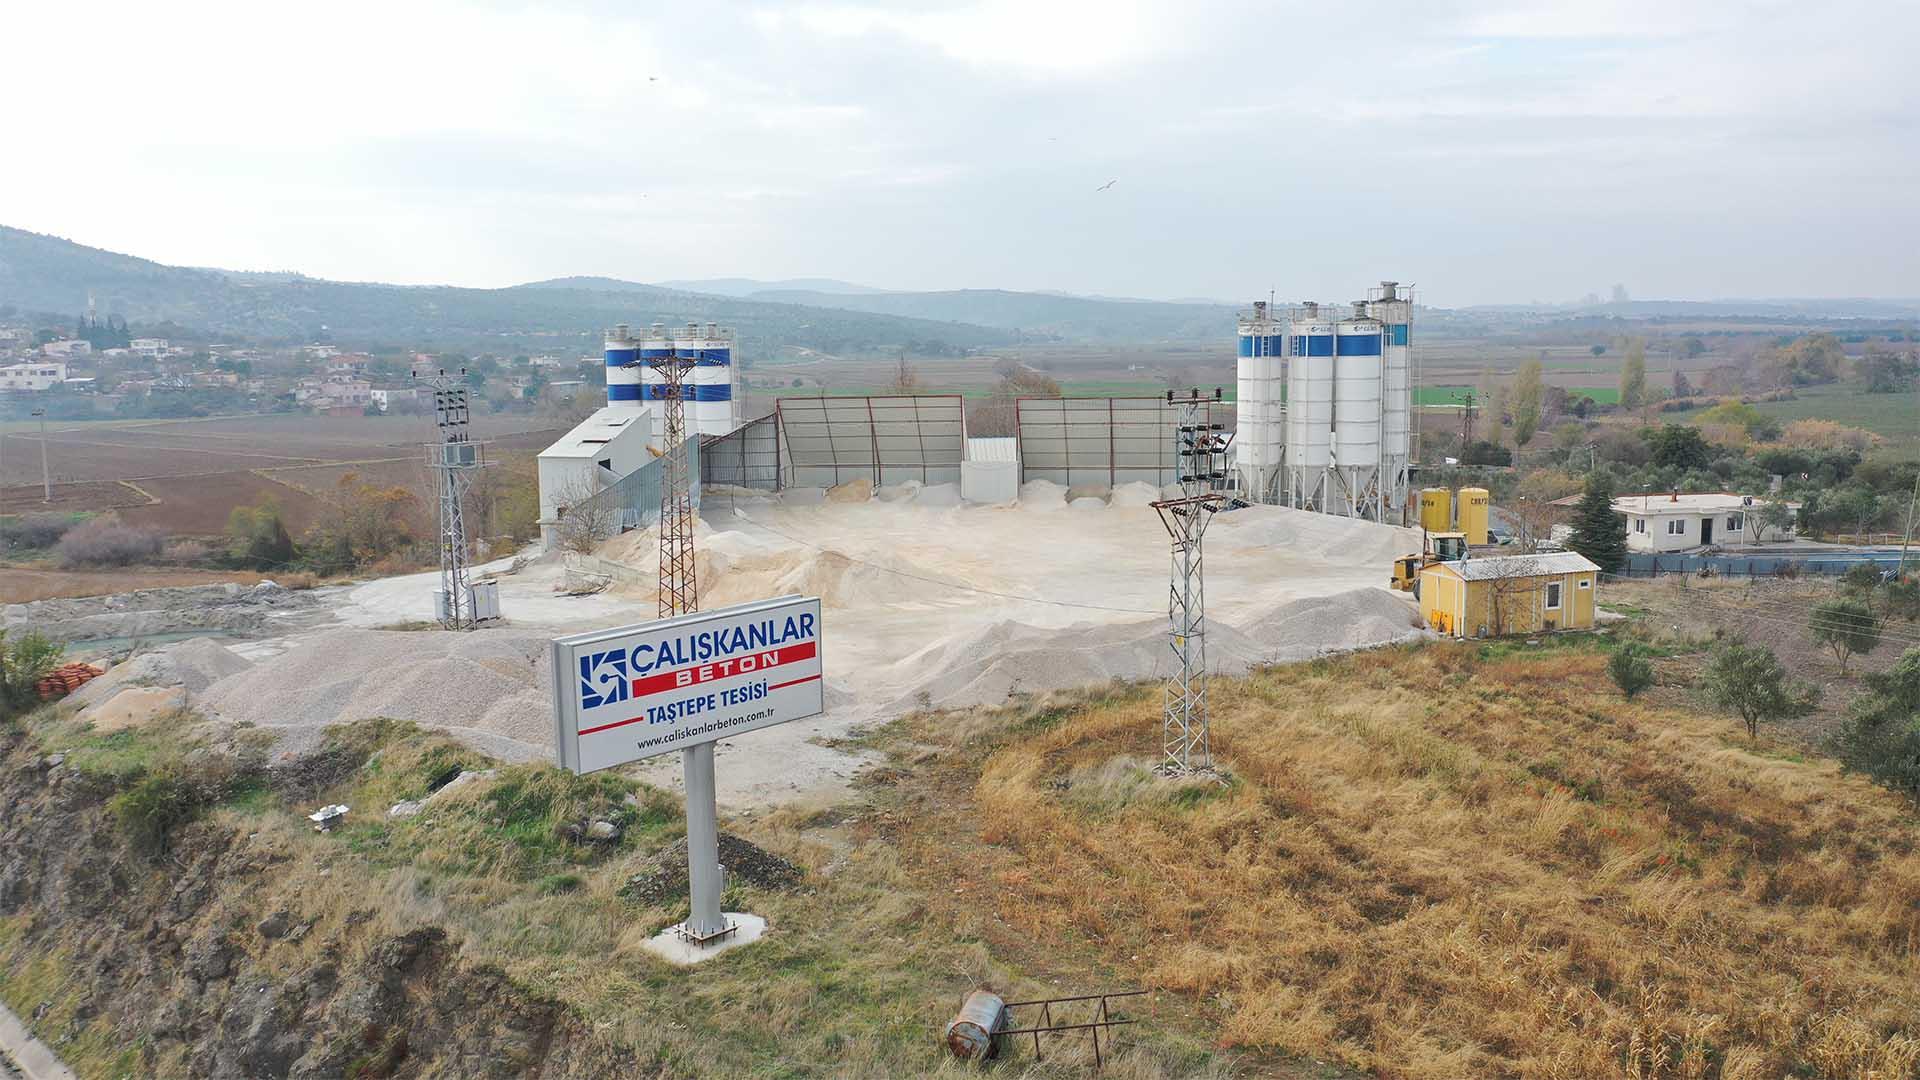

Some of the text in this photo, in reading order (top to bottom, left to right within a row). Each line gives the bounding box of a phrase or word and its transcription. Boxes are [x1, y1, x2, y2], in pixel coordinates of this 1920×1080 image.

[631, 613, 815, 676] ÇALIŞKANLAR
[676, 651, 780, 687] BETON
[647, 678, 769, 724] TAŞTEPE TESİSİ
[637, 707, 775, 749] www.caliskanlarbeton.com.tr
